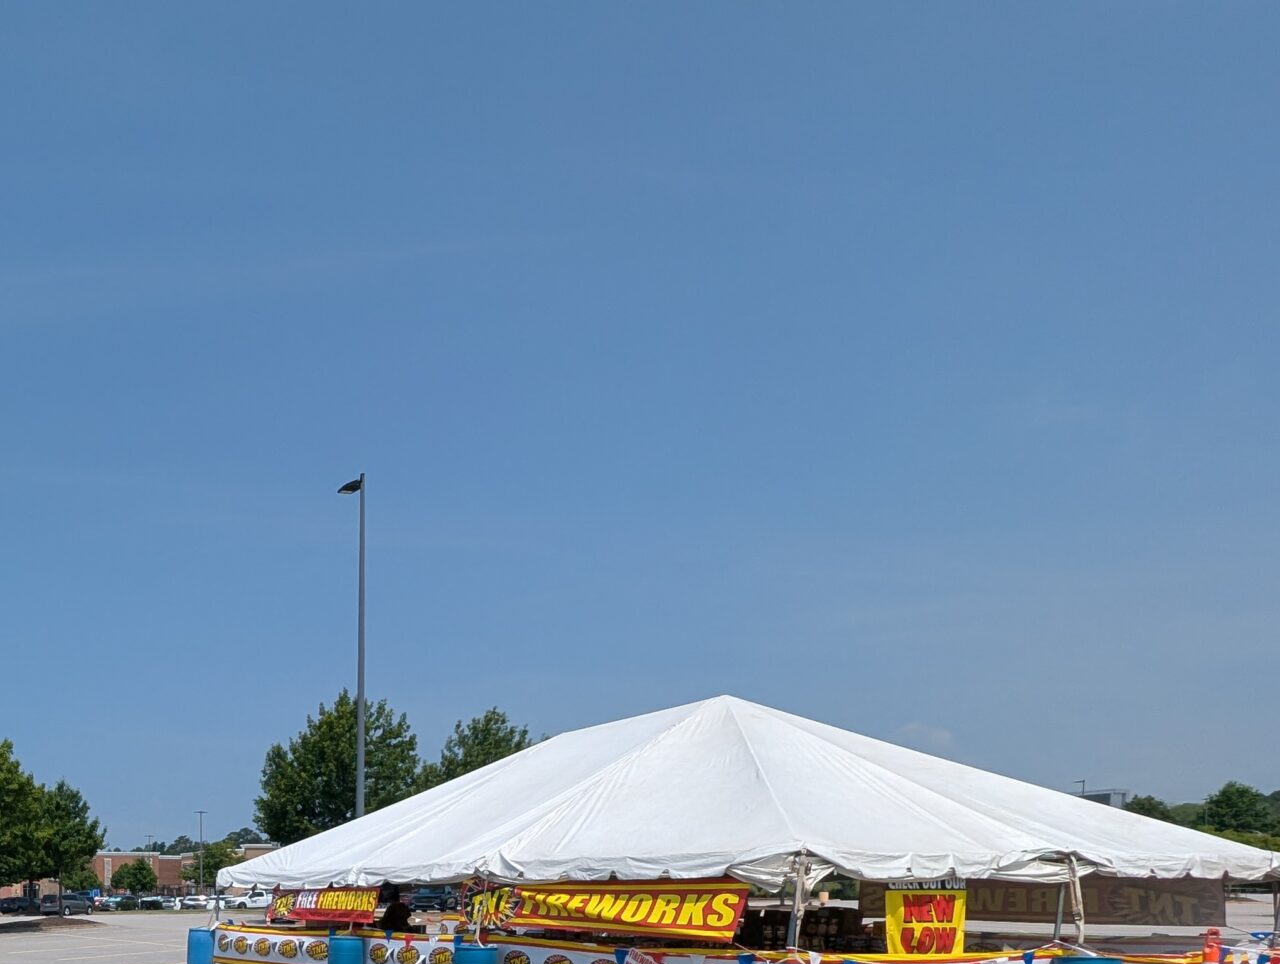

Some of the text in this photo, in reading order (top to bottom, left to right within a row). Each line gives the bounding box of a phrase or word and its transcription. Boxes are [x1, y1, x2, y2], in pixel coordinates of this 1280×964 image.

[296, 890, 377, 912] FREE FIREWORKS
[520, 889, 740, 927] FIREWORKS
[903, 894, 956, 923] NEW
[901, 926, 956, 954] LOW
